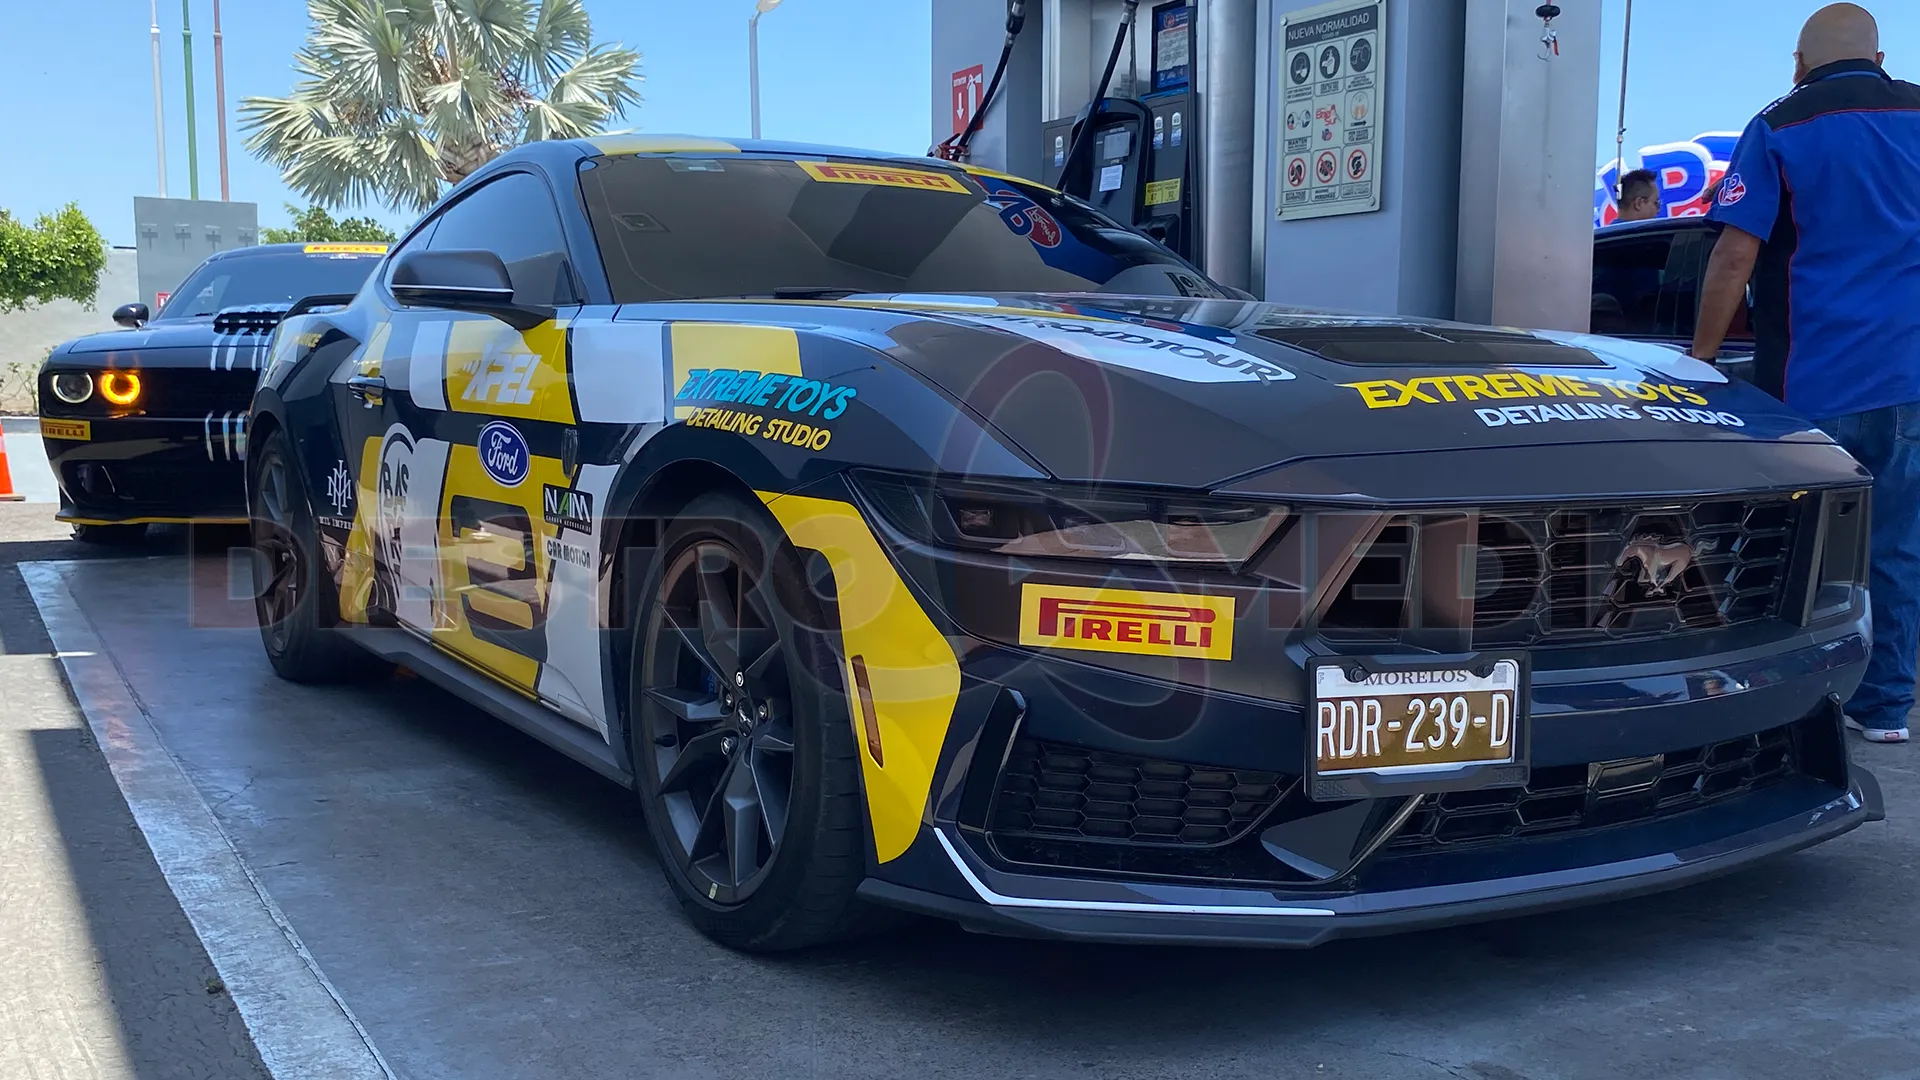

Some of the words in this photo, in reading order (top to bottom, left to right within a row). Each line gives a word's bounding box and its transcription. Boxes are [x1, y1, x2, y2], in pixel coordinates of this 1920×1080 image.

[1288, 27, 1314, 41] NUEVA
[1315, 12, 1370, 34] NORMALIDAD
[815, 165, 952, 188] PIRELLI
[461, 344, 542, 405] XPEL
[1341, 373, 1600, 408] EXTREME
[1588, 377, 1708, 406] TOYS
[674, 369, 784, 406] EXTREME
[774, 377, 857, 420] TOYS
[686, 408, 764, 436] DETAILING
[762, 418, 832, 451] STUDIO
[1474, 402, 1641, 427] DETAILING
[1649, 406, 1746, 427] STUDIO
[488, 431, 519, 475] Ford
[545, 487, 591, 523] NAIM
[1038, 597, 1216, 648] PIRELLI
[1364, 669, 1468, 687] MORELOS
[1316, 693, 1511, 759] RDR-239-D
